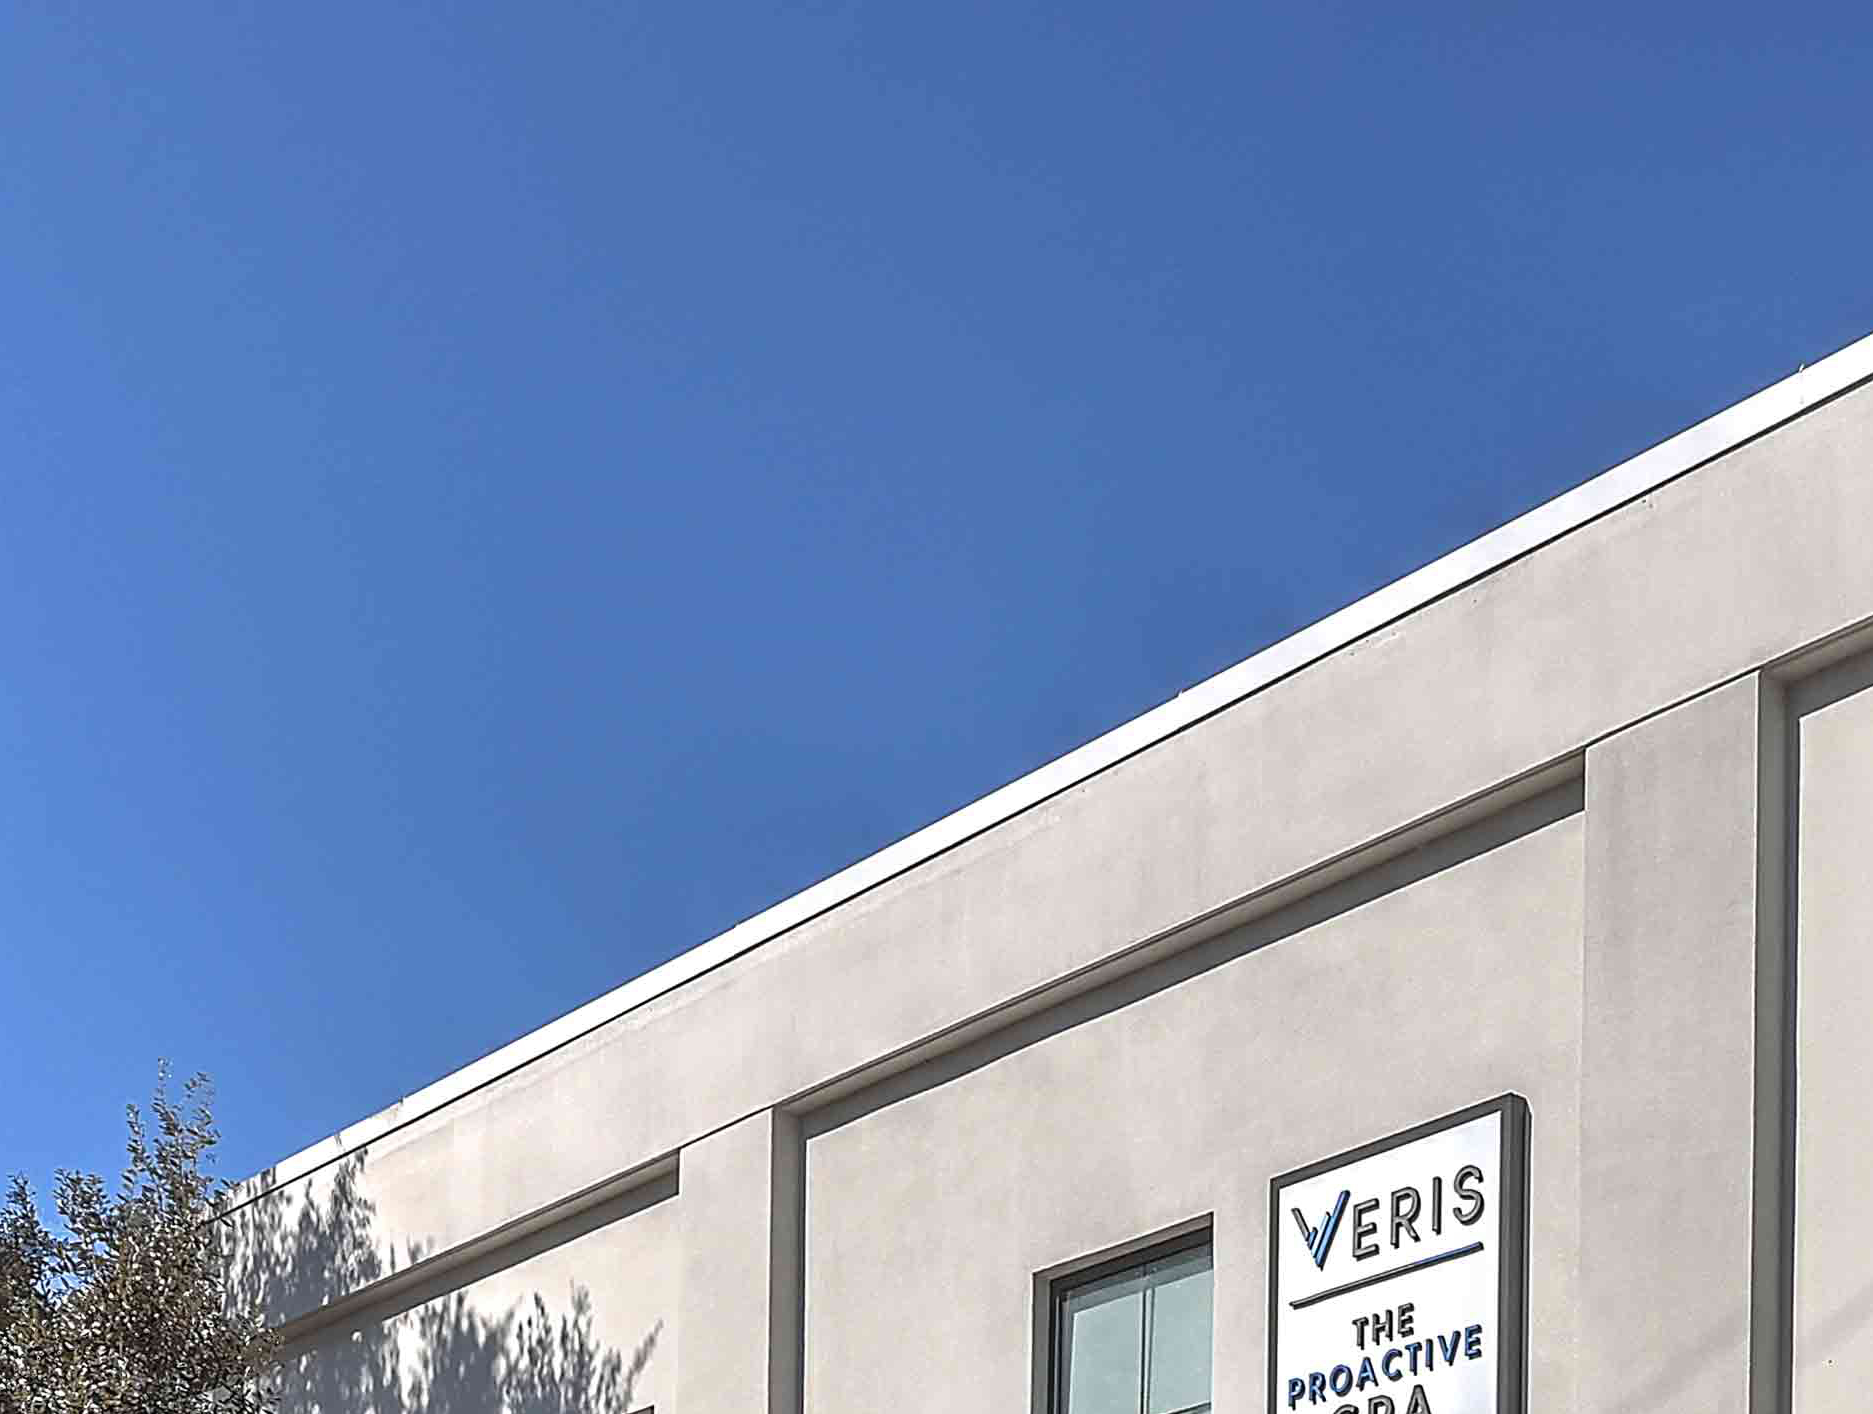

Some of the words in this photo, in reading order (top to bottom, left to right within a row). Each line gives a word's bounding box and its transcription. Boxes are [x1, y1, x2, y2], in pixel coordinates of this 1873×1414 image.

[1290, 1164, 1486, 1272] VERIS
[1287, 1324, 1483, 1411] PROACTIVE
[1352, 1302, 1416, 1351] THE
